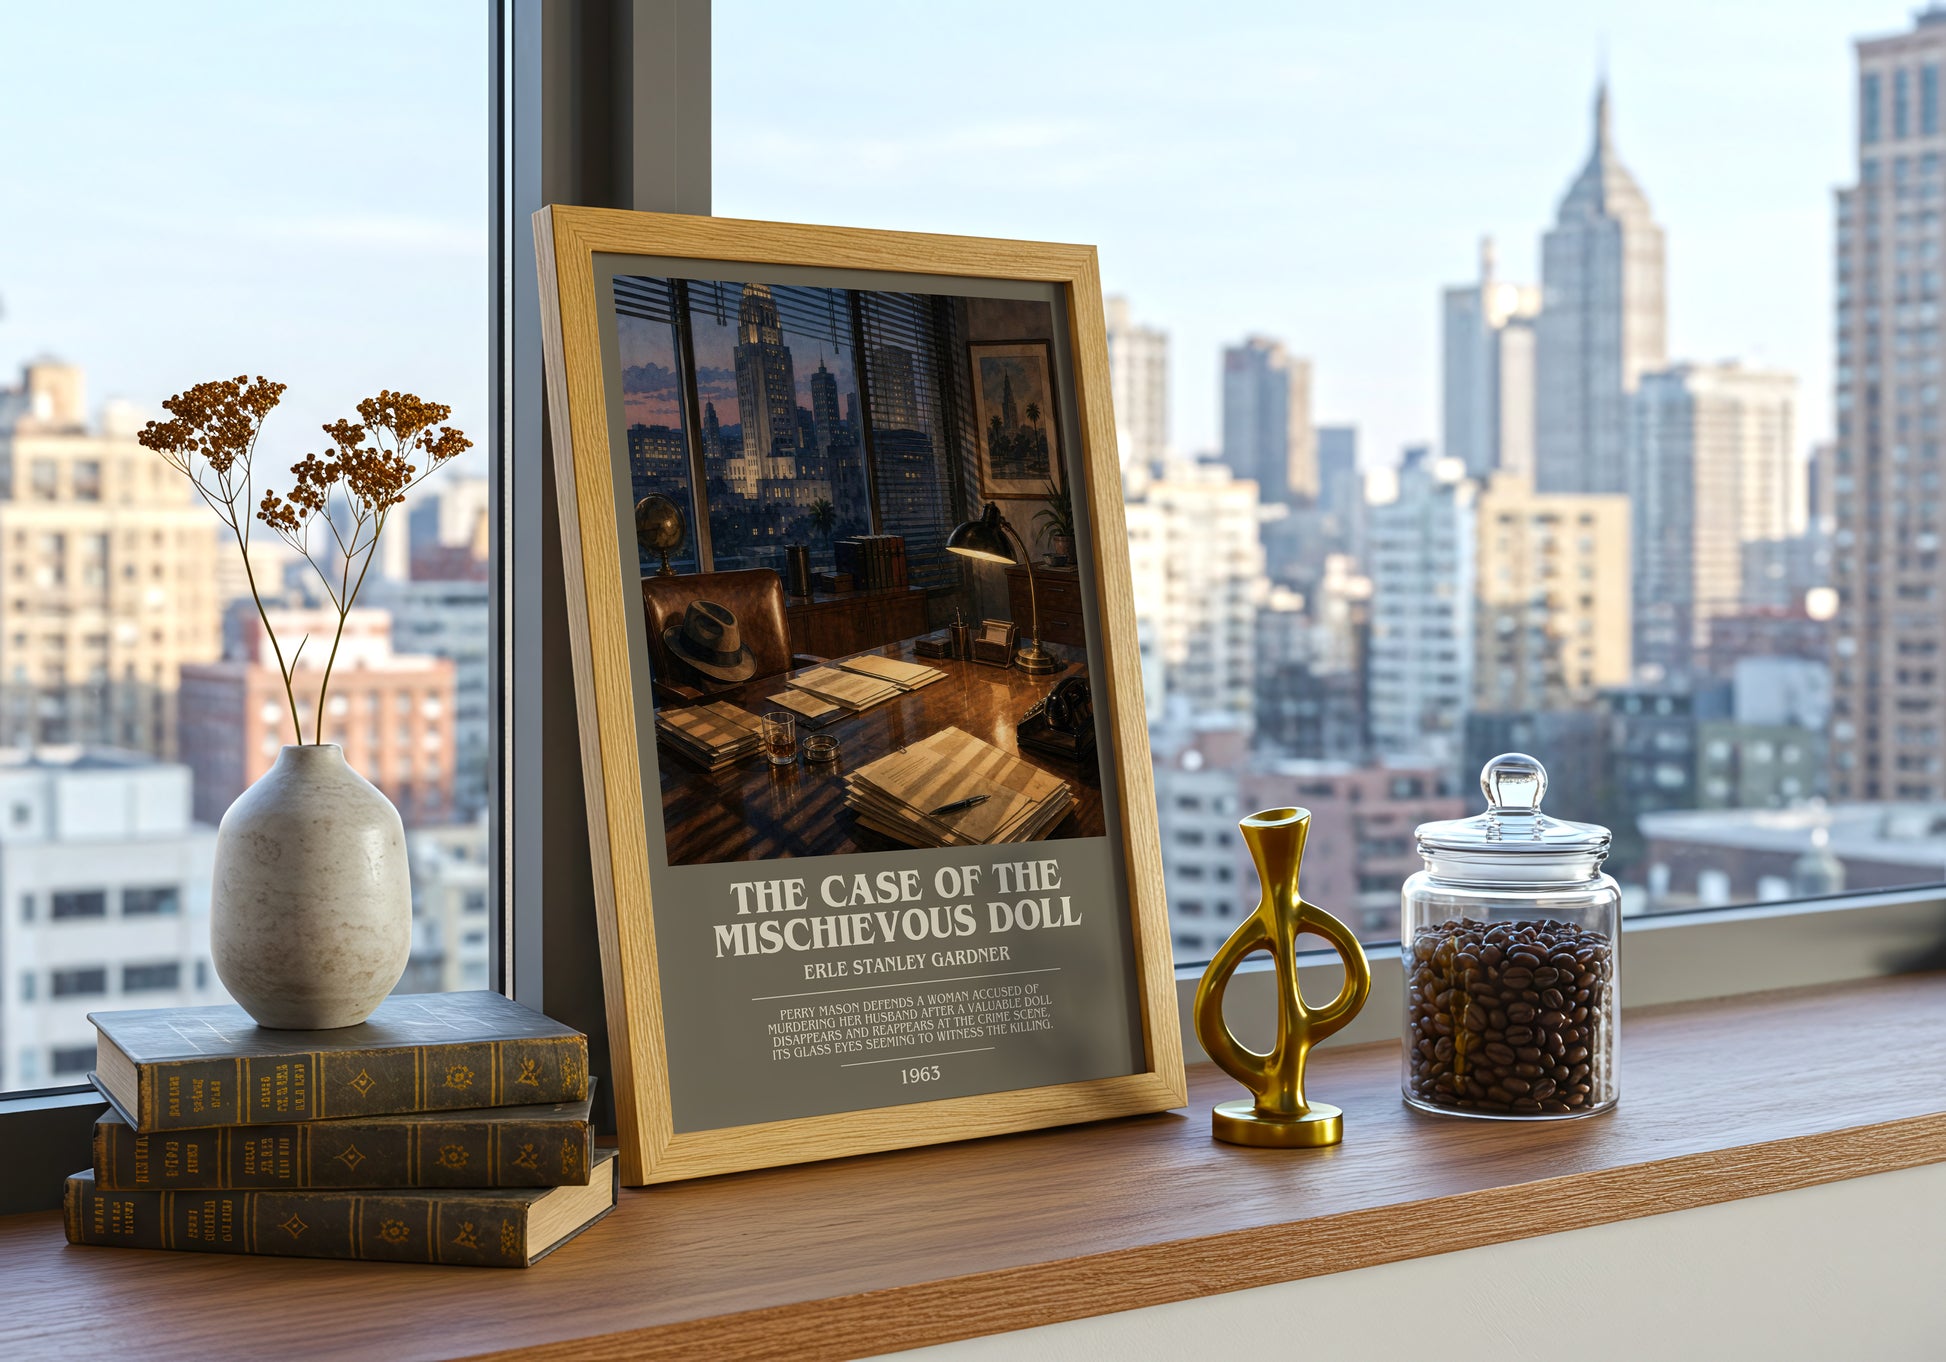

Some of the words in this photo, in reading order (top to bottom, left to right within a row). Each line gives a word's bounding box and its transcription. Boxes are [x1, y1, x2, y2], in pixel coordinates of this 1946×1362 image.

[730, 877, 809, 915] THE
[820, 869, 923, 908] CASE
[934, 865, 982, 899] OF
[991, 859, 1062, 895] THE
[713, 903, 977, 958] MISCHIEVOUS
[987, 896, 1082, 934] DOLL
[803, 961, 849, 980] ERLE
[853, 954, 927, 975] STANLEY
[931, 946, 1011, 968] GARDNER
[768, 1018, 836, 1035] MURDERING
[839, 1015, 862, 1027] HER
[865, 1009, 918, 1024] HUSBAND
[921, 1005, 955, 1018] AFTER
[957, 1004, 965, 1014] A
[967, 998, 1022, 1013] VALUABLE
[1024, 995, 1052, 1007] DOLL
[780, 1007, 815, 1020] PERRY
[819, 1002, 860, 1016] MASON
[863, 997, 914, 1012] DEFENDS
[917, 995, 924, 1006] A
[927, 991, 969, 1004] WOMAN
[972, 985, 1022, 1000] ACCUSED
[1024, 983, 1039, 995] OF
[772, 1048, 791, 1060] ITS
[794, 1044, 832, 1058] GLASS
[835, 1040, 863, 1054] EYES
[865, 1034, 915, 1050] SEEMING
[918, 1032, 934, 1044] TO
[936, 1026, 984, 1041] WITNESS
[986, 1024, 1007, 1036] THE
[1010, 1019, 1054, 1033] KILLING.
[773, 1030, 842, 1048] DISAPPEARS
[845, 1027, 869, 1039] AND
[872, 1020, 935, 1036] REAPPEARS
[937, 1018, 953, 1029] AT
[953, 1015, 975, 1027] THE
[977, 1011, 1010, 1025] CRIME
[1013, 1007, 1051, 1020] SCENE,
[900, 1065, 941, 1085] 1963
